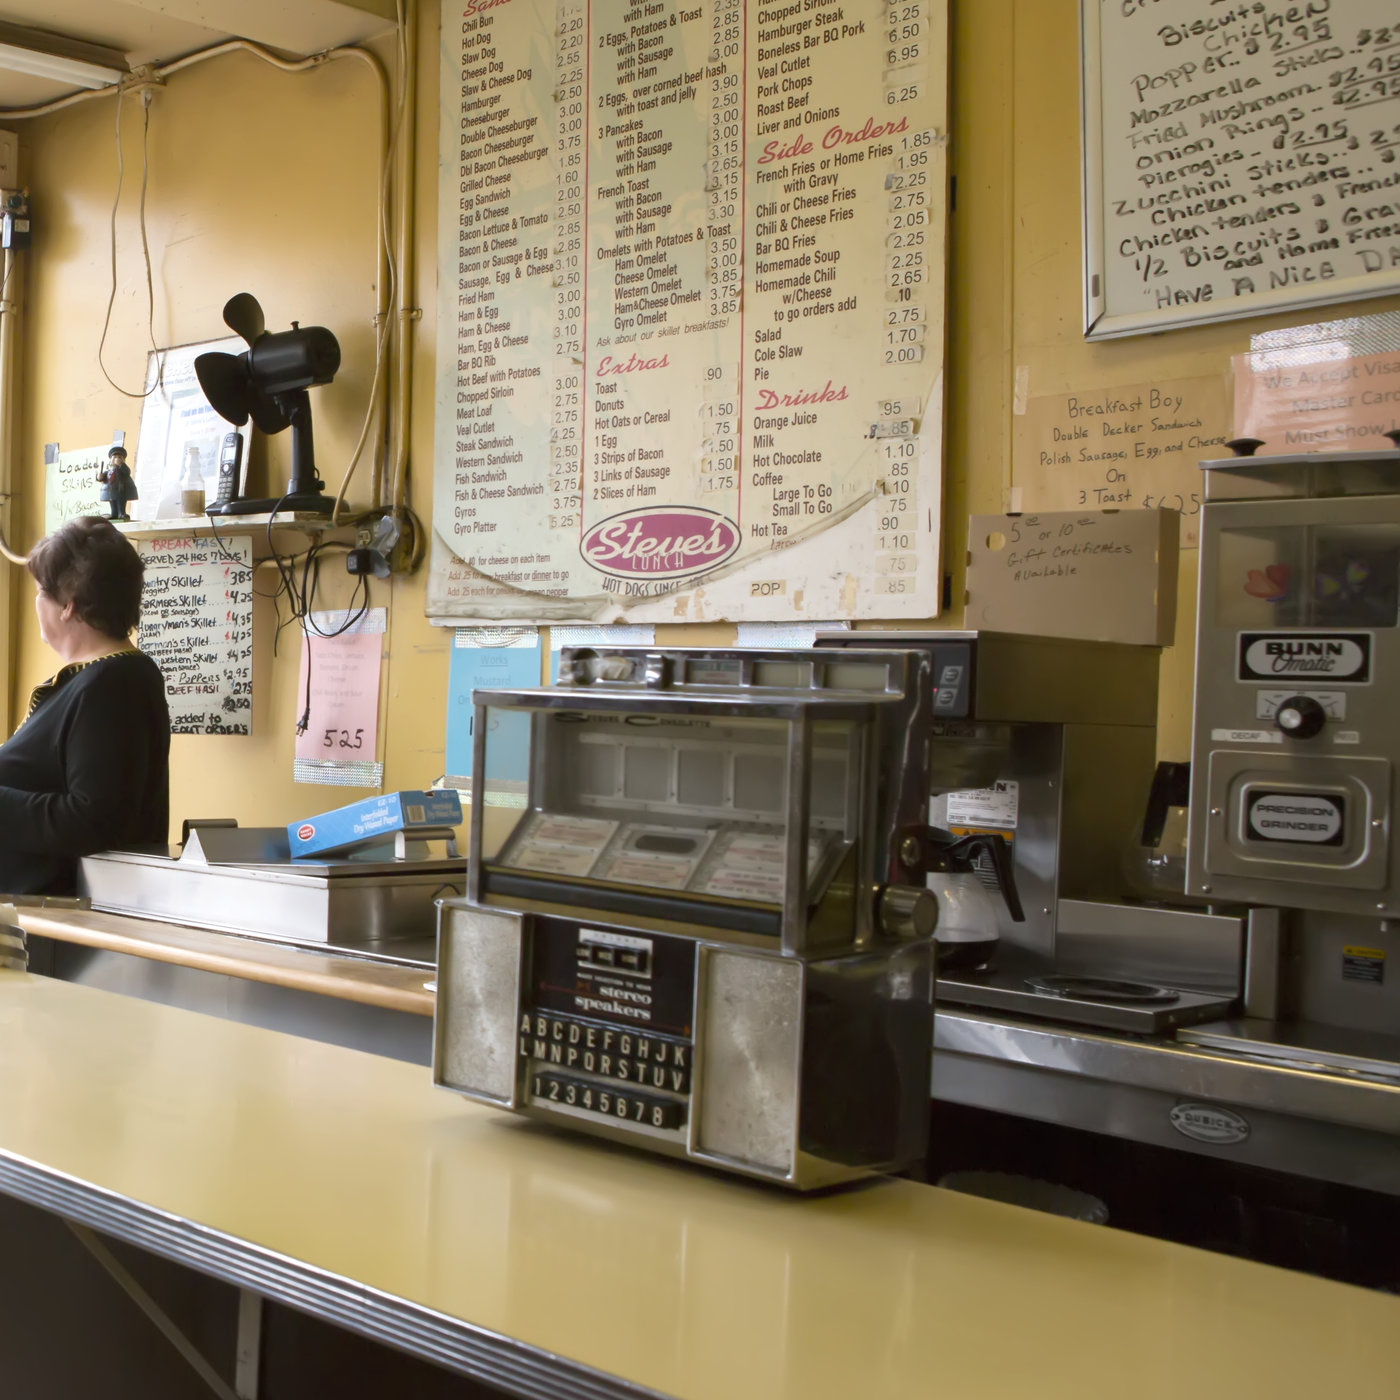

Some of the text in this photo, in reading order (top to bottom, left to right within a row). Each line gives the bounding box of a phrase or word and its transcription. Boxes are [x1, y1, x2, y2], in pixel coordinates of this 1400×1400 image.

[462, 16, 493, 33] Chili Bun
[758, 17, 812, 43] Hamburger
[815, 8, 844, 27] Steak
[462, 32, 491, 50] Hot Dog
[461, 65, 487, 81] Cheese
[489, 60, 504, 76] Dog
[758, 74, 813, 99] Pork Chops
[461, 94, 501, 113] Hamburger
[757, 92, 810, 118] Roast Beef
[1131, 77, 1261, 128] Mozzarella
[461, 108, 510, 129] Cheeseburger
[757, 106, 840, 136] Liver and Onions
[461, 116, 538, 145] Double Cheeseburger
[598, 127, 603, 139] 3
[605, 119, 644, 137] Pancakes
[757, 116, 909, 164] Side Orders
[460, 172, 511, 193] Grilled Cheese
[597, 178, 650, 200] French Toast
[755, 249, 840, 274] Homemade Soup
[1136, 254, 1168, 282] 1/2
[615, 264, 678, 286] Cheese Omelet
[755, 266, 836, 293] Homemade Chili
[615, 278, 682, 300] Western Omelet
[755, 327, 782, 343] Salad
[754, 344, 803, 362] Cole Slaw
[596, 353, 671, 377] Extras
[595, 399, 624, 412] Donuts
[754, 380, 849, 411] Drinks
[1068, 389, 1182, 418] Breakfast Boy
[456, 404, 492, 420] Meat Loaf
[753, 411, 818, 430] Orange Juice
[753, 435, 774, 449] Milk
[1053, 426, 1088, 442] Double
[1103, 422, 1143, 437] Decker
[594, 448, 664, 466] 3 Strips of Bacon
[753, 450, 822, 468] Hot Chocolate
[1040, 451, 1071, 466] Polish
[1164, 441, 1183, 453] and
[59, 456, 99, 474] Loaded
[708, 476, 733, 490] 1.75
[752, 472, 783, 487] Coffee
[1106, 468, 1126, 483] On
[593, 484, 656, 500] 2 Slices of Ham
[1079, 488, 1132, 504] 3 Toast
[454, 506, 476, 518] Gyros
[454, 520, 497, 535] Gyro Platter
[590, 517, 727, 561] Steve's
[632, 551, 684, 571] LUNCH
[1265, 642, 1343, 656] BUNN
[1256, 803, 1334, 817] PRECISION
[1261, 819, 1329, 832] GRINDER
[599, 985, 652, 1005] stereo
[574, 996, 651, 1020] speakers
